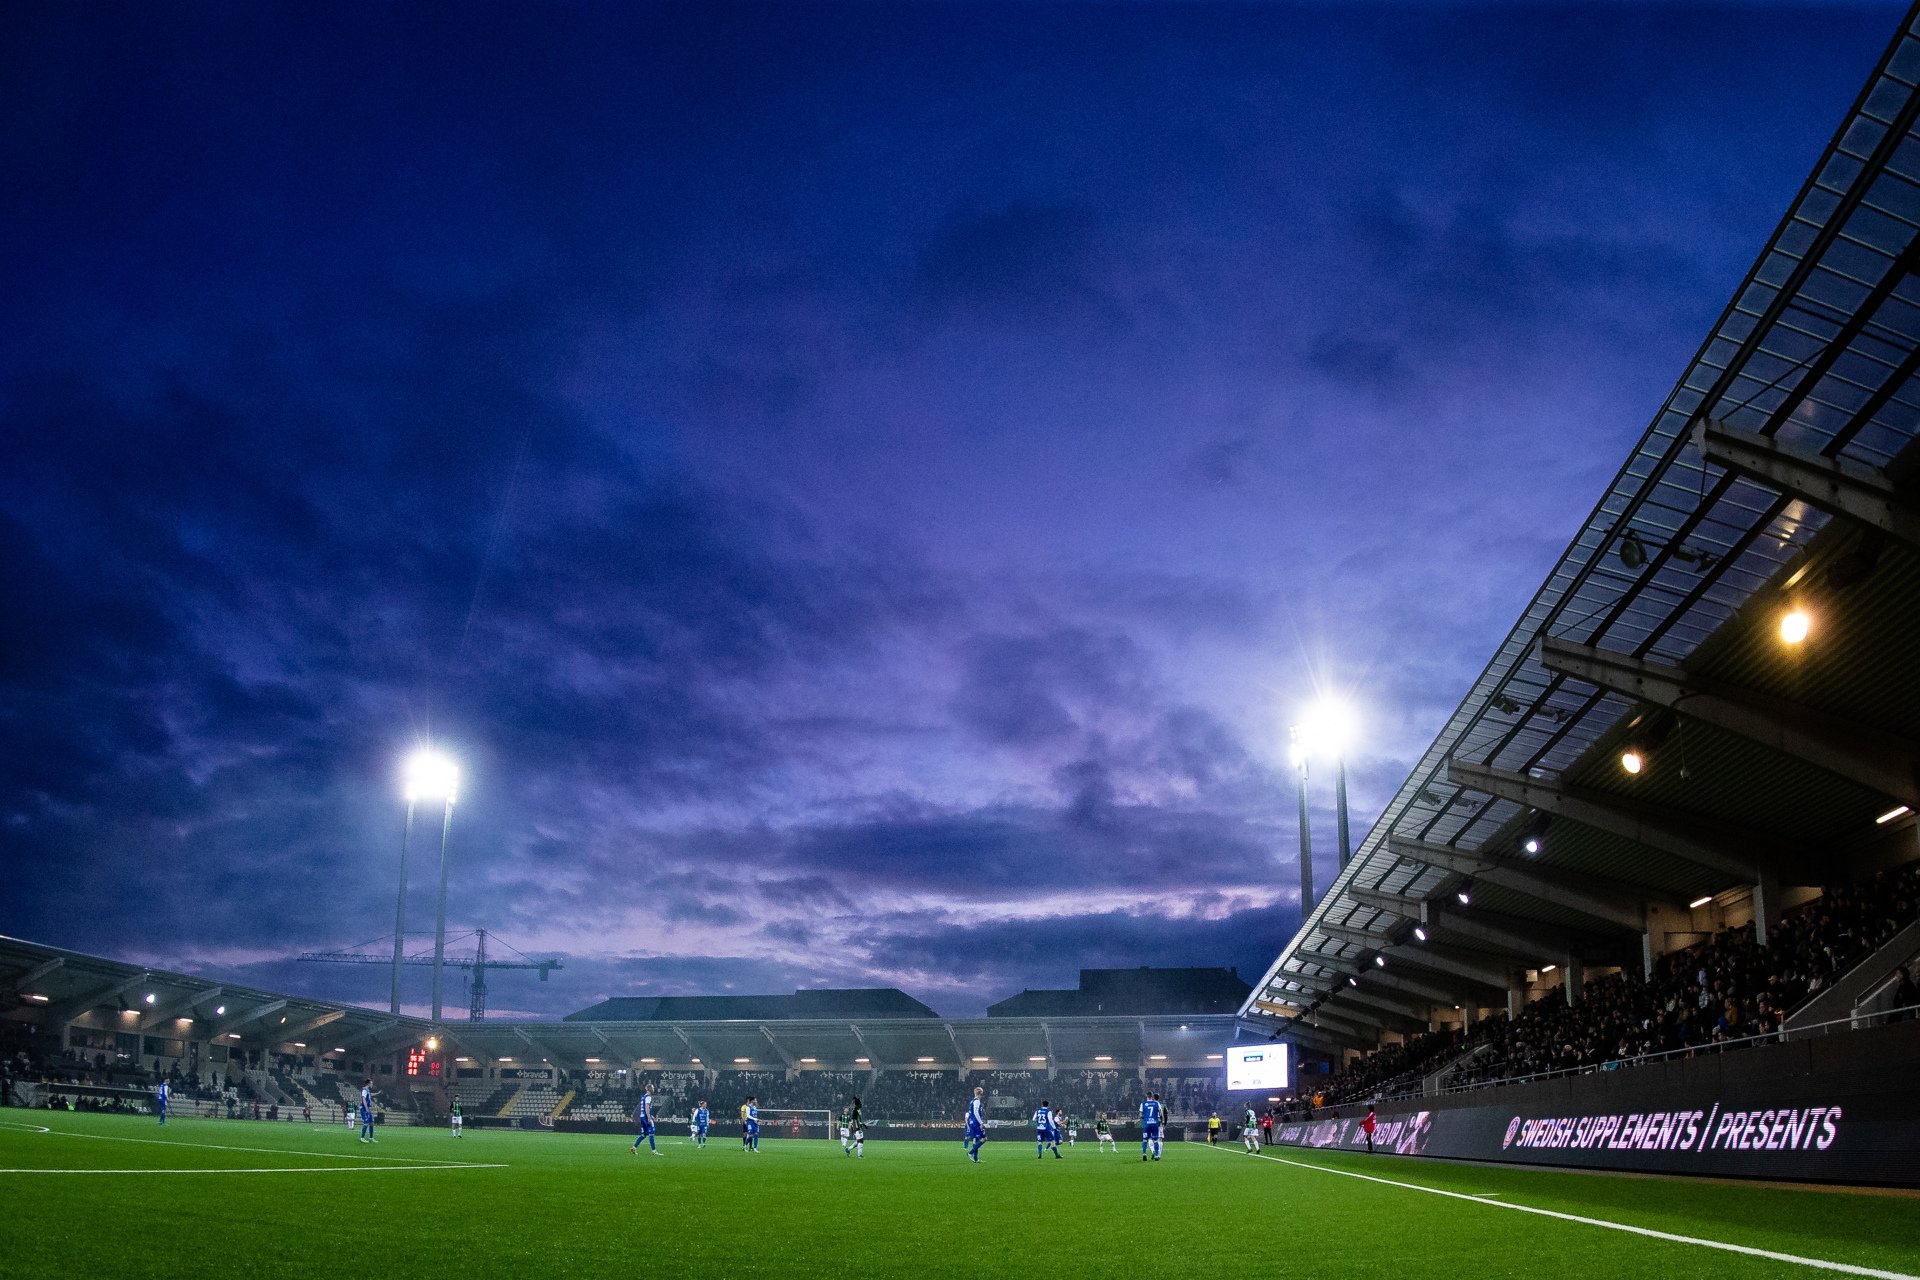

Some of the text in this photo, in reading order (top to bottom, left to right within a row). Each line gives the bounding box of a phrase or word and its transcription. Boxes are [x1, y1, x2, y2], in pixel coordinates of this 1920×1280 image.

[1147, 1106, 1154, 1117] 7
[1037, 1113, 1047, 1124] 23
[1516, 1118, 1577, 1148] SWEDISH
[1570, 1110, 1704, 1150] SUPPLEMENTS
[1711, 1105, 1842, 1151] PRESENTS
